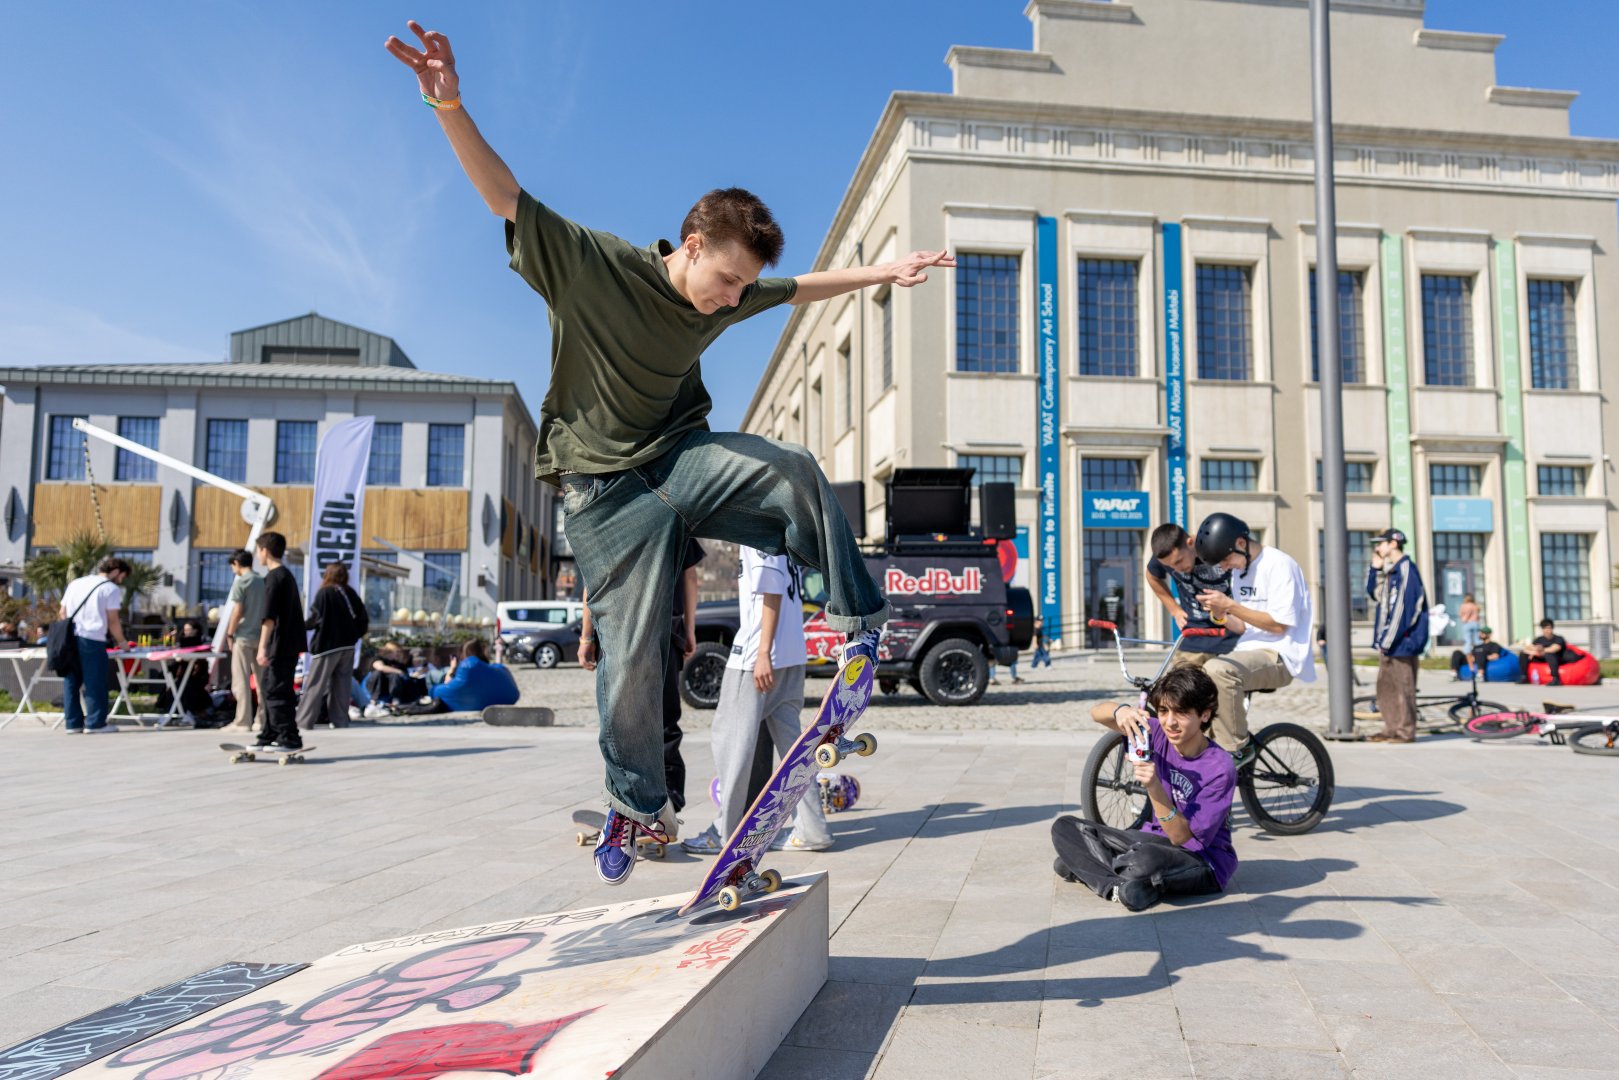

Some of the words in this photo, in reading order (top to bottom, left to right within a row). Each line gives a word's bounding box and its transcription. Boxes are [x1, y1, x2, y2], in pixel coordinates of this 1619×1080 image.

[1041, 283, 1053, 315] School
[1042, 319, 1053, 336] Art
[1042, 337, 1056, 409] Contemporary
[1042, 411, 1054, 446] YARAT
[1170, 414, 1182, 449] YARAT
[1043, 472, 1055, 516] Infinite
[1092, 498, 1141, 511] YARAT
[1172, 467, 1185, 528] onsuzluğa
[316, 493, 357, 579] REAL
[1045, 519, 1055, 532] to
[1044, 535, 1056, 569] Finite
[1045, 572, 1056, 604] From
